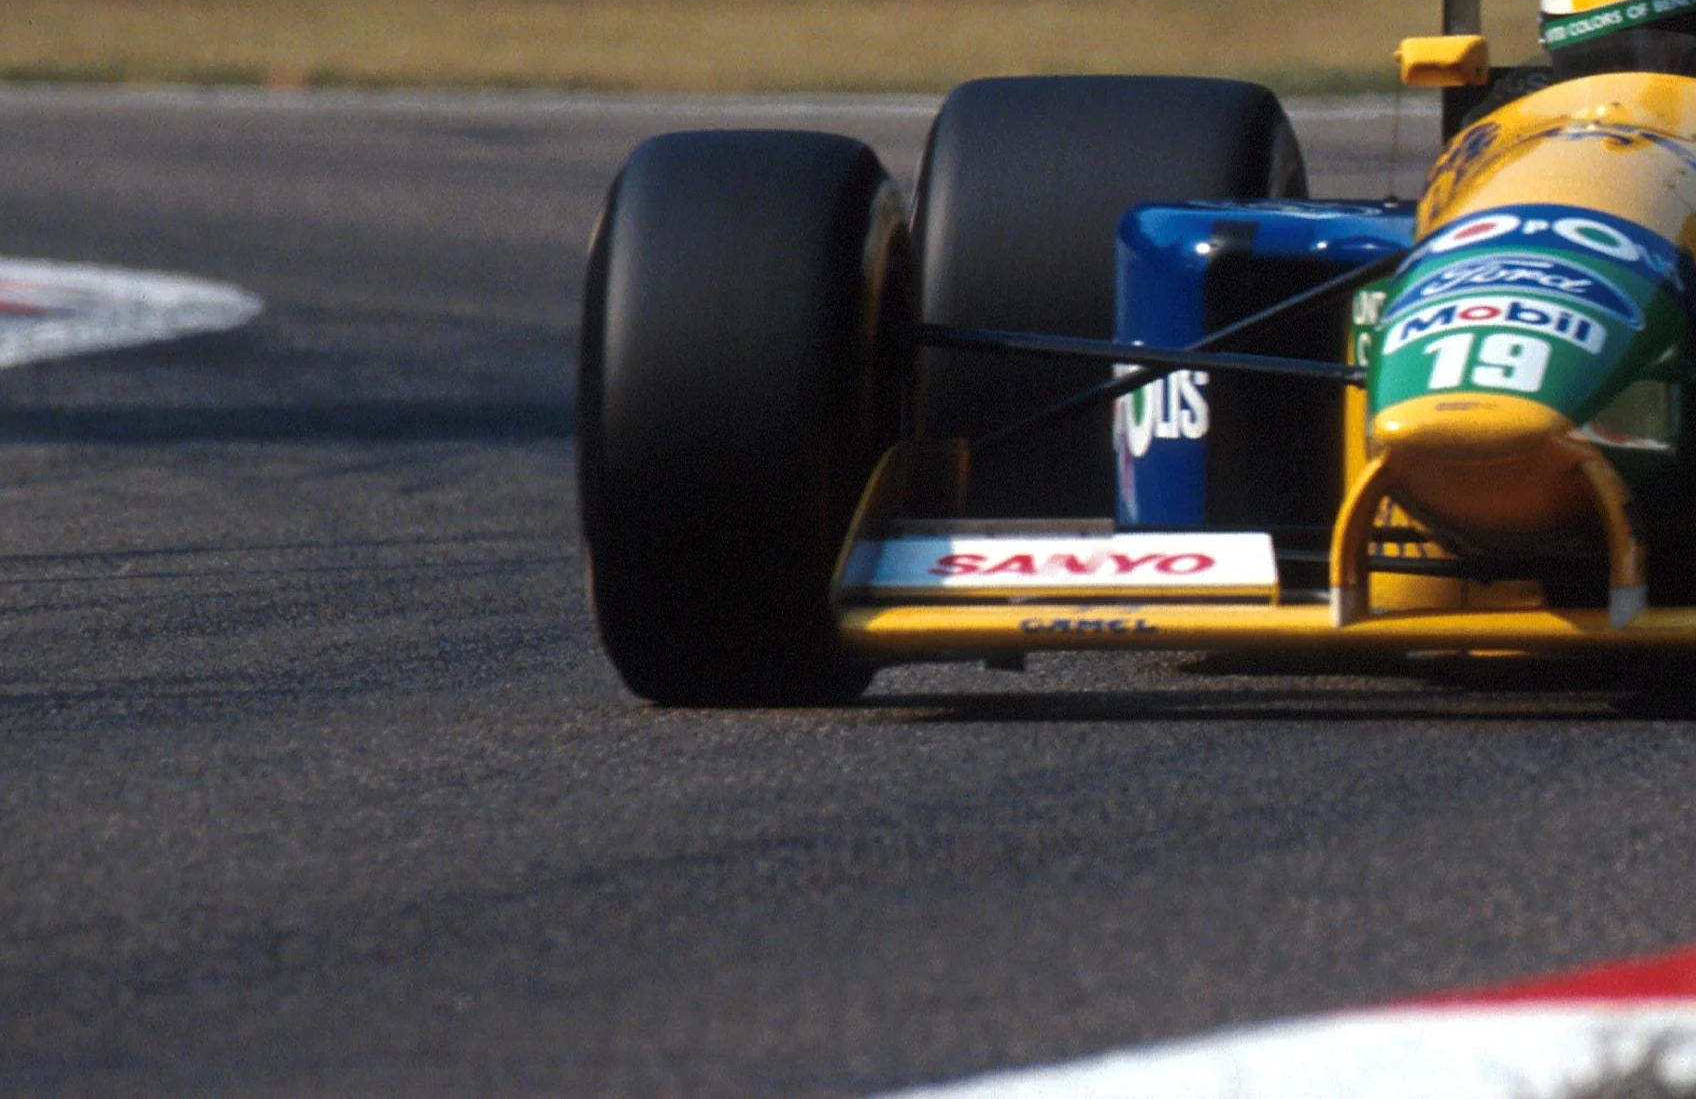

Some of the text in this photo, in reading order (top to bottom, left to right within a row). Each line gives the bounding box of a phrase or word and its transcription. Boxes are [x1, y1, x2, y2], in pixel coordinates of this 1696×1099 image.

[1626, 2, 1650, 20] OF
[1420, 260, 1592, 295] Ford
[1398, 302, 1592, 343] Mobil
[1422, 332, 1551, 393] 19
[927, 551, 1217, 577] SANYO
[1018, 616, 1160, 634] CAMEL
